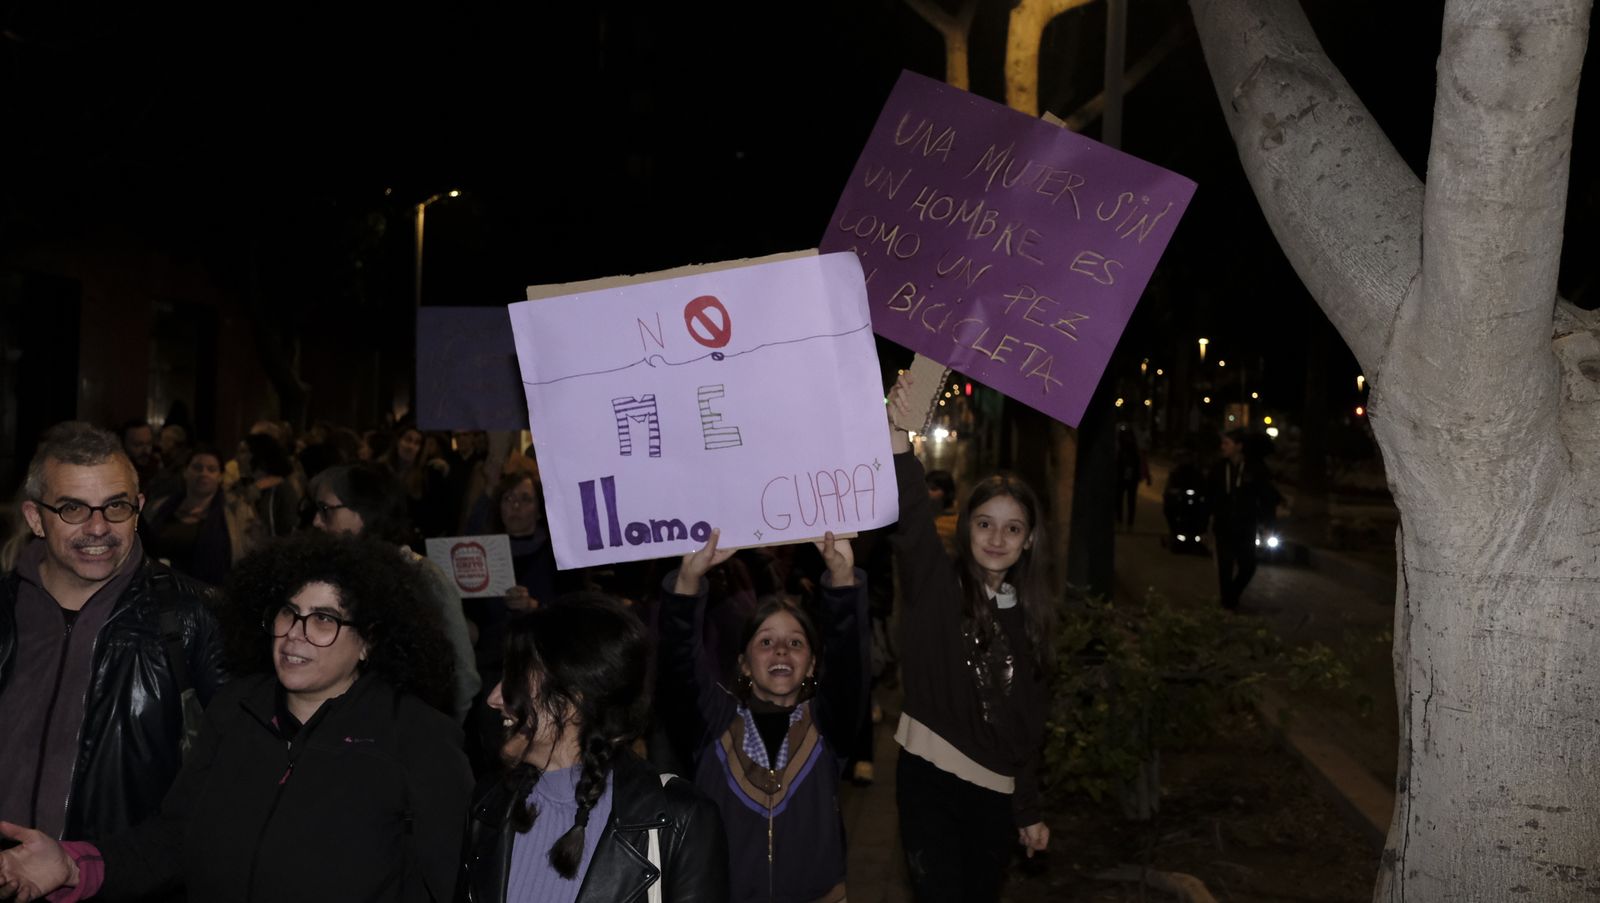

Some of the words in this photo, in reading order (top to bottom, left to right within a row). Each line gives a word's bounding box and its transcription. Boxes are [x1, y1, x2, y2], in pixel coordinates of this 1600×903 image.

[895, 113, 957, 162] UNA
[864, 167, 912, 200] UN
[1070, 250, 1123, 285] ES
[839, 209, 921, 258] COMO
[936, 248, 993, 288] UN
[1003, 285, 1090, 341] PEZ
[887, 282, 1063, 392] BICICLETA
[611, 384, 743, 458] ME
[761, 464, 875, 530] GUAPA
